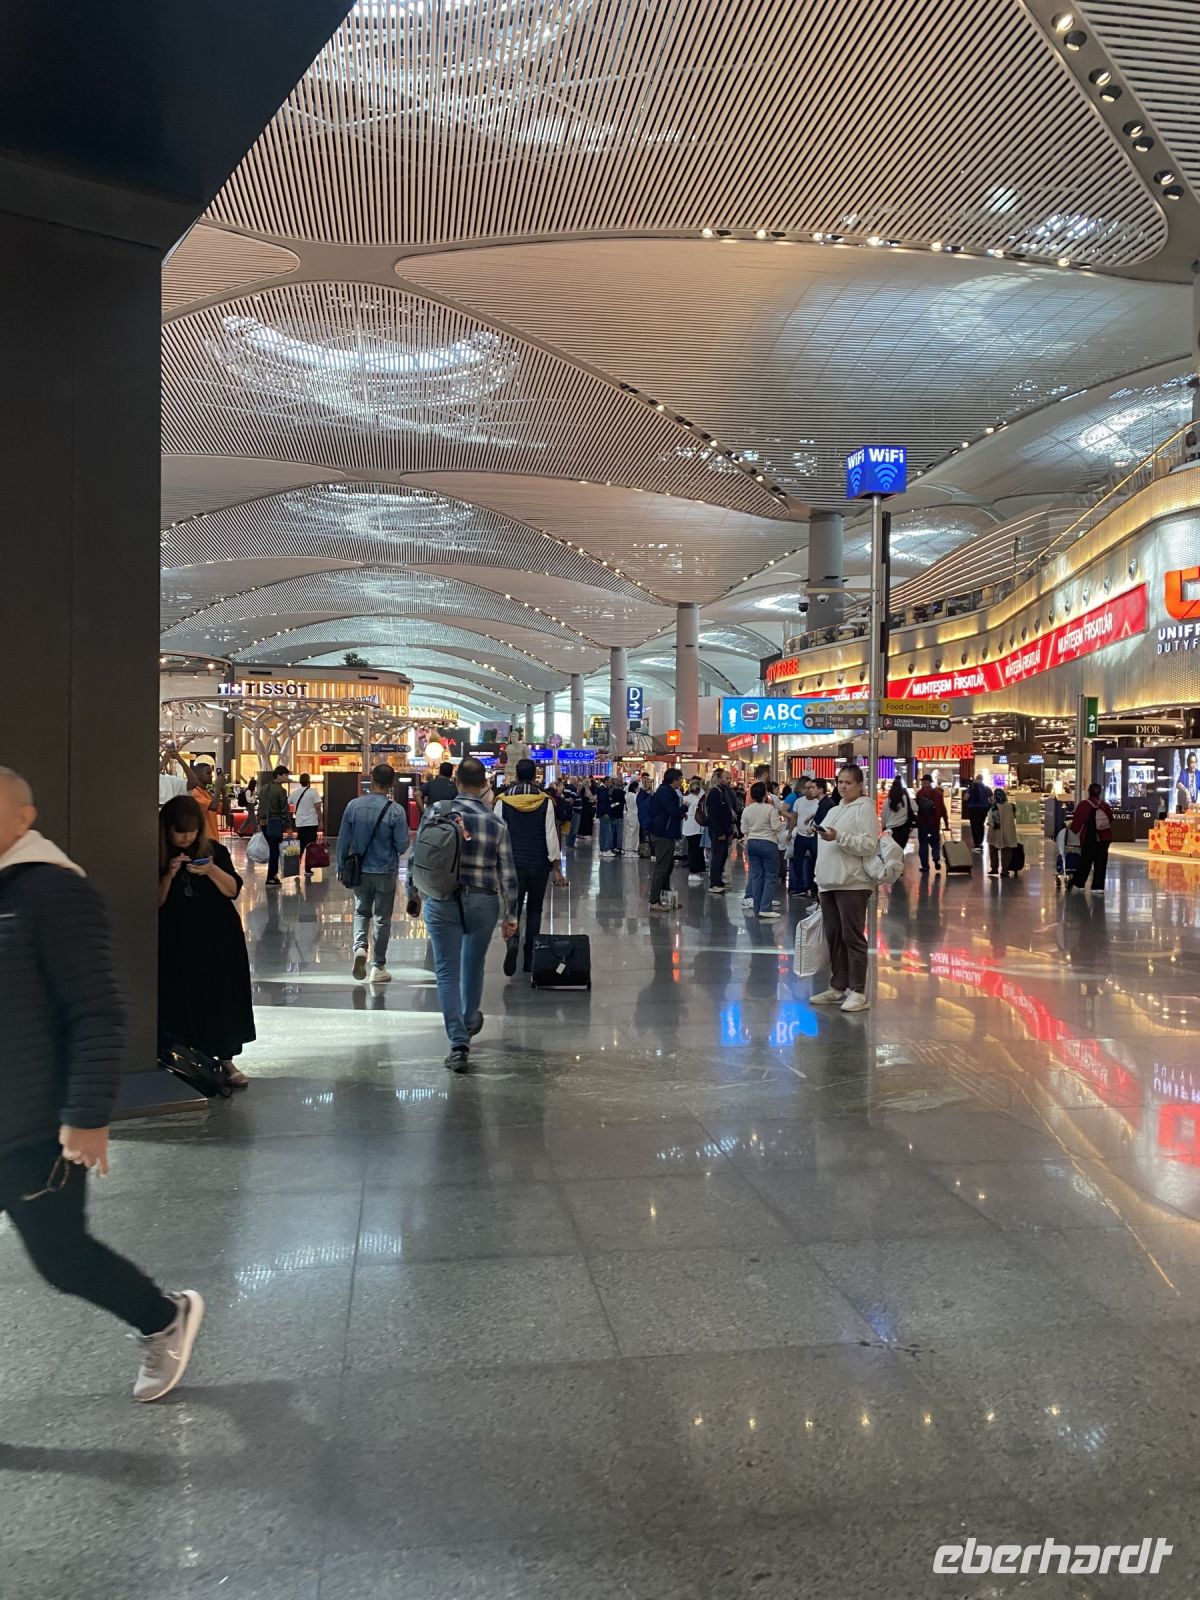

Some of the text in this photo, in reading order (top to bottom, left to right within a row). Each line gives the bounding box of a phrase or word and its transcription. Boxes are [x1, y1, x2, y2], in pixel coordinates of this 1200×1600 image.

[847, 449, 864, 470] WiFi
[868, 448, 904, 463] WiFi
[777, 659, 798, 676] FREE
[246, 683, 308, 695] TISSOT
[912, 673, 985, 696] MUHTEŞEM FIRSATLAR
[630, 687, 640, 700] D
[763, 703, 802, 720] ABC
[886, 702, 903, 710] Food
[905, 702, 924, 710] Court
[1136, 725, 1161, 734] DIOR
[916, 743, 974, 760] DUTY FREE
